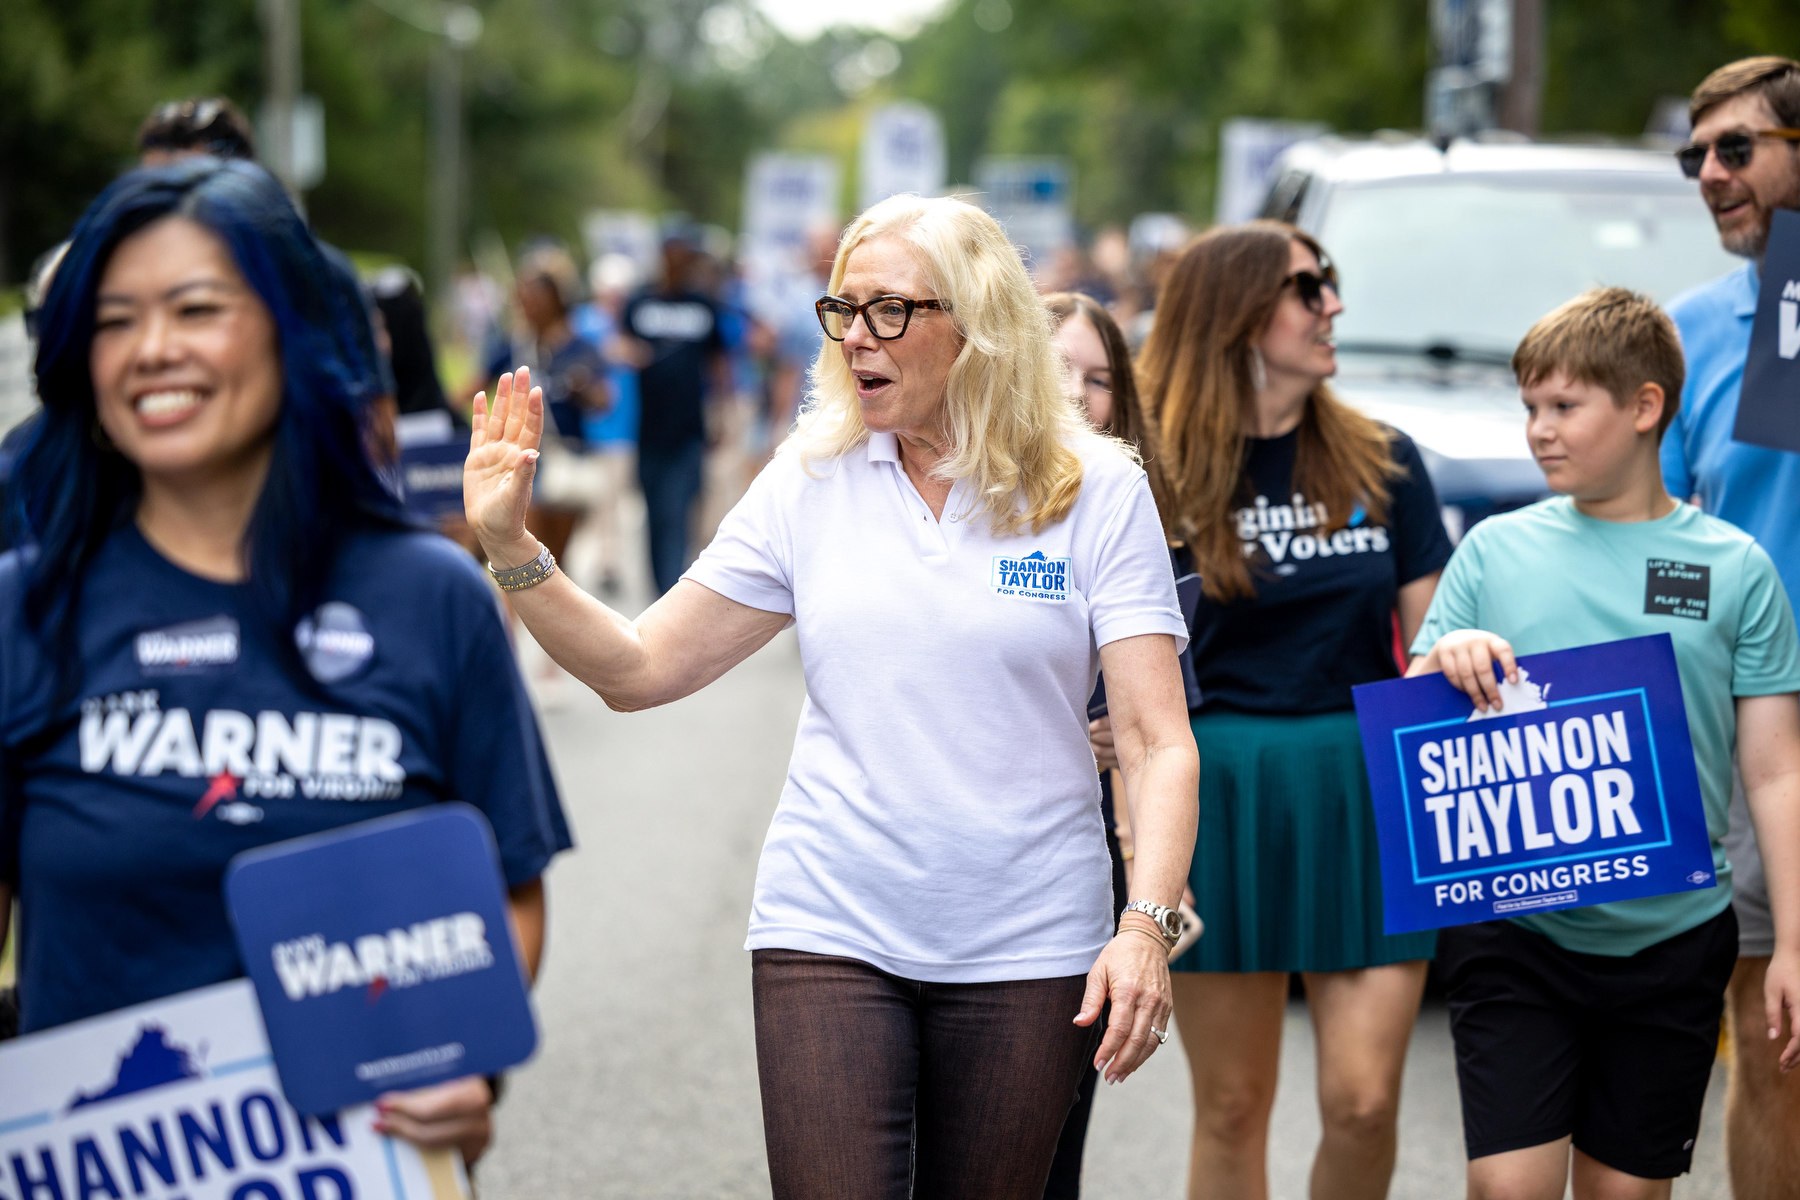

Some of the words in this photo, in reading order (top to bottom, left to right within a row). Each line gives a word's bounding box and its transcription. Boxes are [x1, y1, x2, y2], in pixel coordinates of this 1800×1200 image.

[1230, 493, 1328, 540] ginia
[1259, 526, 1389, 562] Voters
[999, 560, 1065, 574] SHANNON
[999, 571, 1065, 591] TAYLOR
[1648, 561, 1671, 569] LIFE
[1657, 569, 1666, 577] A
[1667, 570, 1702, 580] SPORT
[1019, 590, 1066, 600] CONGRESS
[1654, 595, 1682, 605] PLAY
[1685, 598, 1706, 609] THE
[1672, 607, 1702, 618] GAME
[80, 707, 405, 780] WARNER
[1418, 711, 1632, 794] SHANNON
[1424, 768, 1642, 864] TAYLOR
[1435, 879, 1485, 906] FOR
[1492, 855, 1650, 897] CONGRESS
[272, 911, 490, 1001] WARNER
[0, 1092, 348, 1200] HANNO
